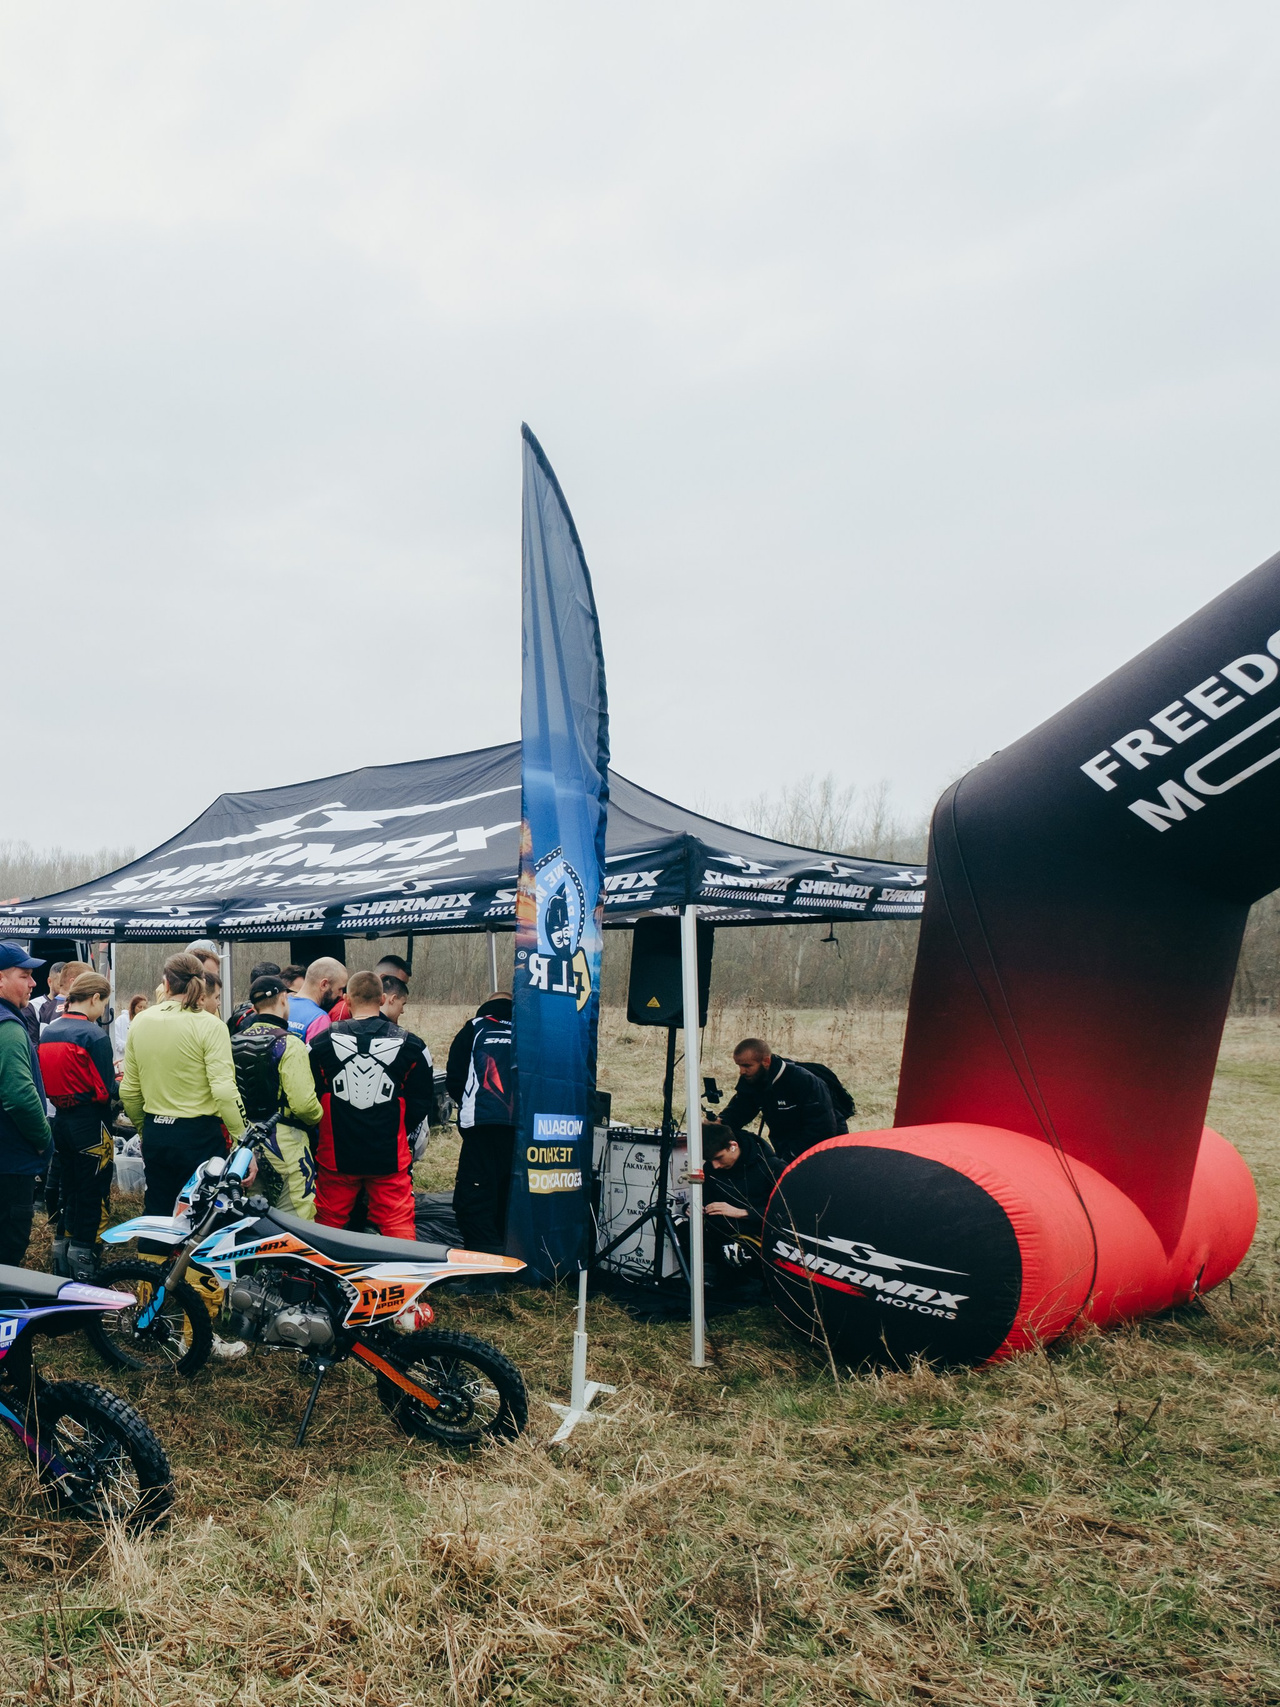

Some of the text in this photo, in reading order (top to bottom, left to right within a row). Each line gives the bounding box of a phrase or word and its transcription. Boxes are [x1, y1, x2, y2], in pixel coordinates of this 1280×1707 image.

[89, 821, 521, 897] SHARMAX
[701, 869, 795, 892] SHARMAX
[795, 879, 874, 900] SHARMAX
[341, 892, 476, 918] SHARMAX
[756, 893, 785, 904] RACE
[877, 888, 926, 902] SHARMA
[842, 900, 867, 911] RACE
[48, 917, 119, 928] SHARMAX
[124, 917, 213, 928] SHARMAX
[218, 906, 329, 926] SHARMAX
[419, 910, 468, 922] RACE
[285, 921, 324, 932] RACE
[211, 1239, 289, 1262] SHARMAX
[772, 1240, 970, 1310] SHARMAX
[362, 1285, 405, 1306] 145
[376, 1298, 405, 1310] SPORT
[876, 1294, 958, 1320] MOTORS
